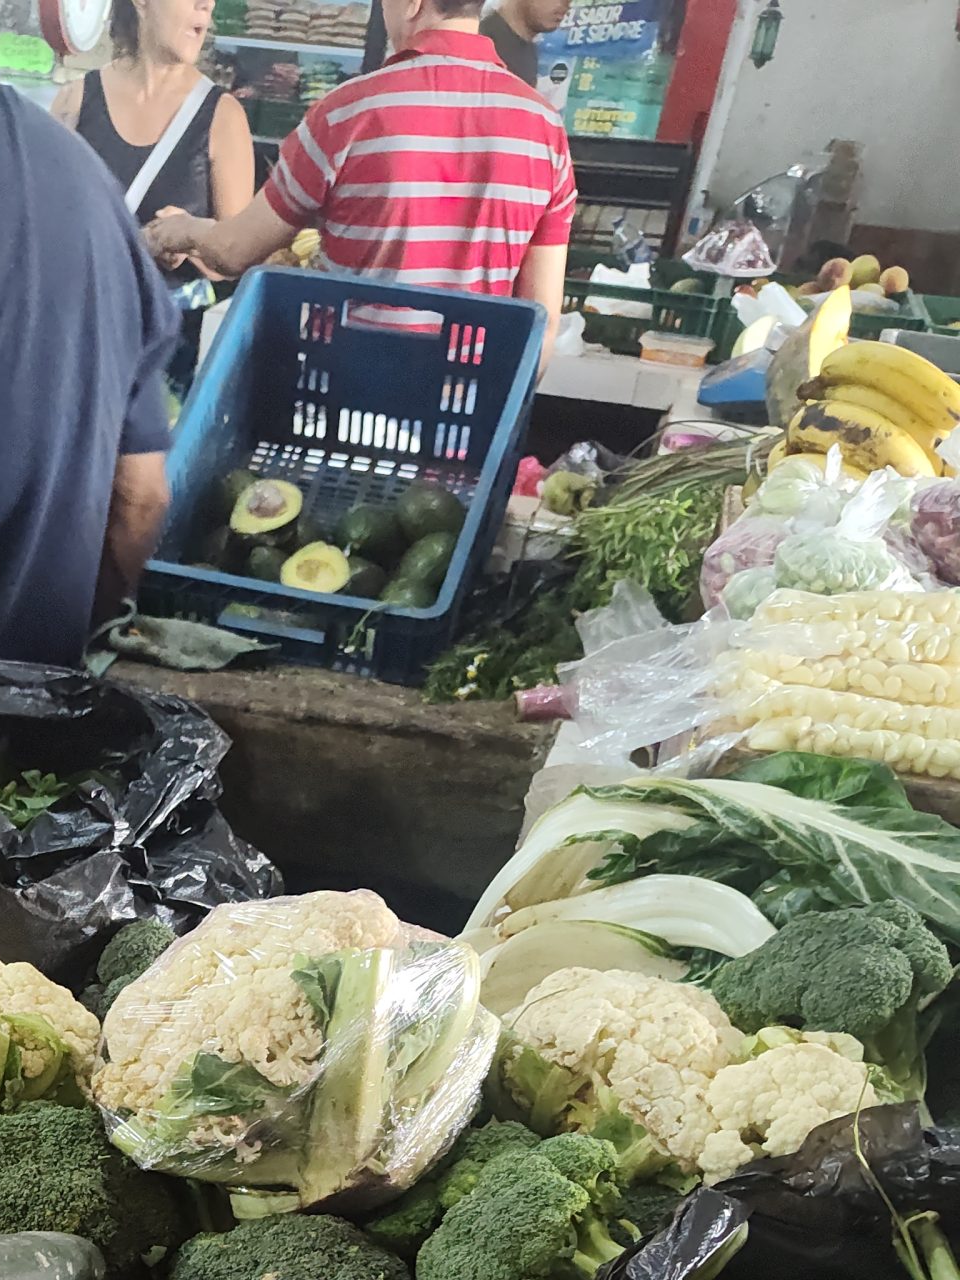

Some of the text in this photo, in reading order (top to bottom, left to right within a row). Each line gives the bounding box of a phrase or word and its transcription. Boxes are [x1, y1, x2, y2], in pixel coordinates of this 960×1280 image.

[577, 4, 623, 26] SABOR
[567, 19, 647, 46] DE SIEMPRE
